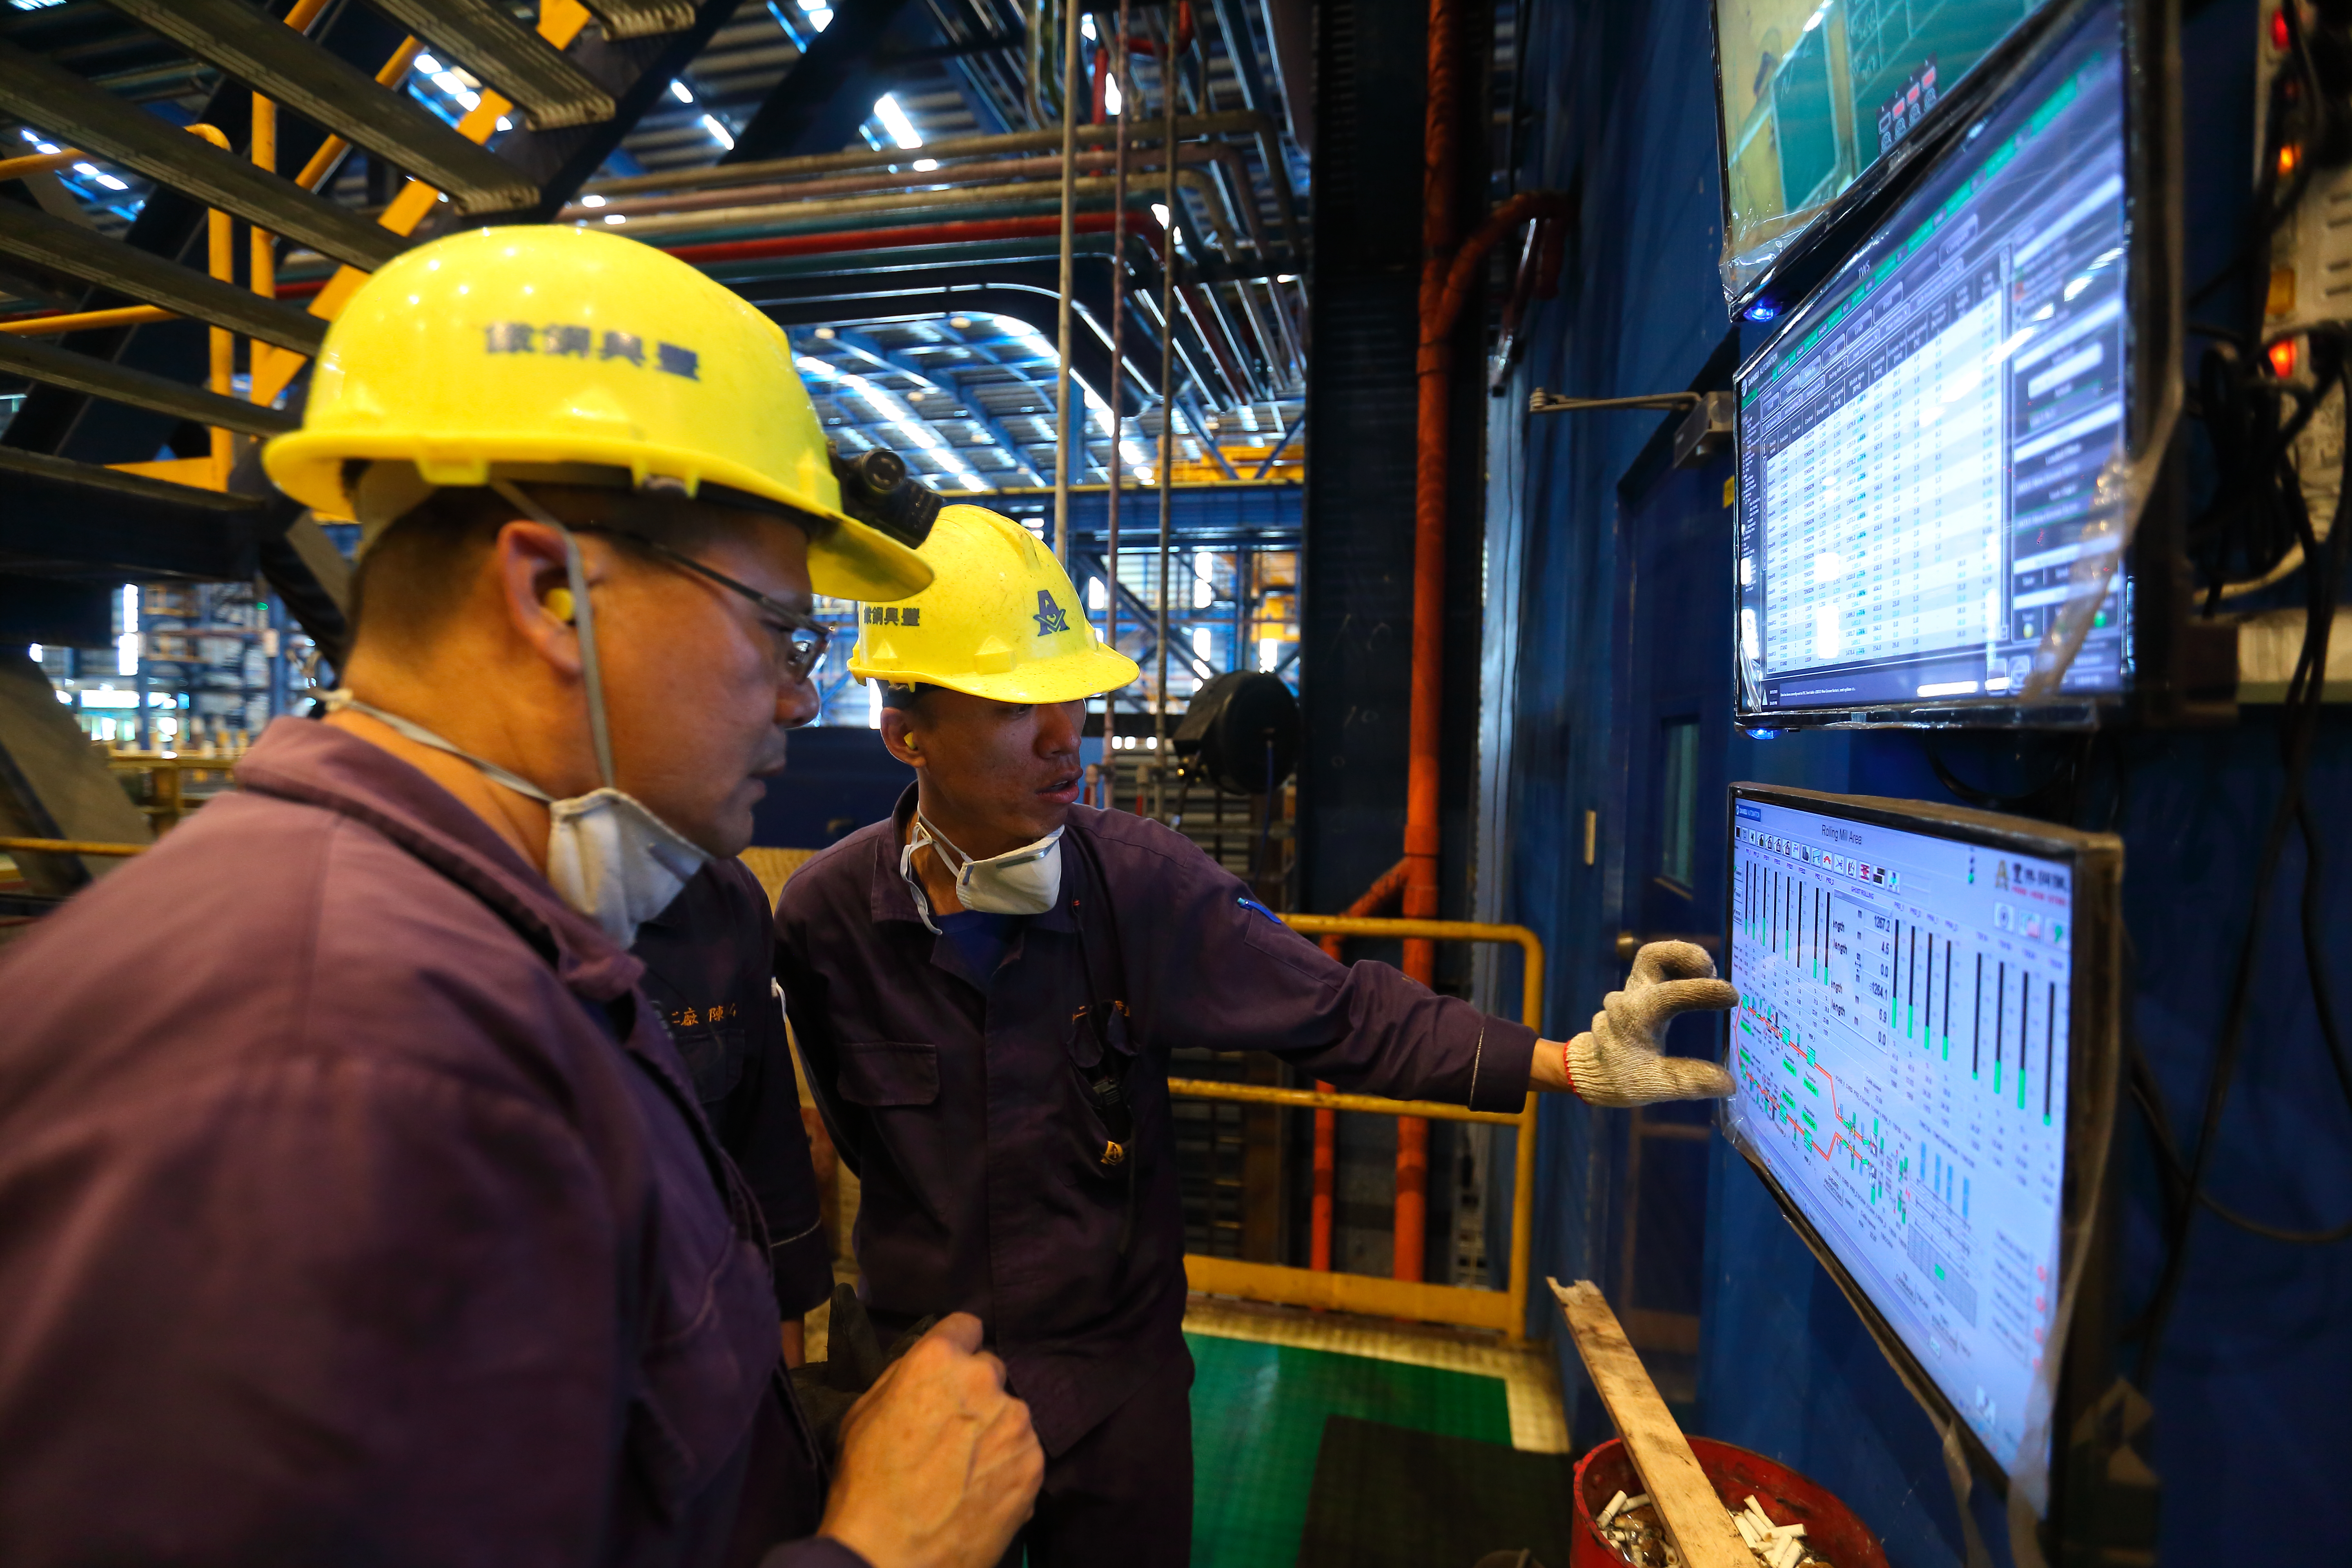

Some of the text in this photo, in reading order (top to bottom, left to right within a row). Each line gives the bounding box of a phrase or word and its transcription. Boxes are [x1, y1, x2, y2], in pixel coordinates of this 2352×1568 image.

[1858, 262, 1869, 280] TWS
[1855, 323, 1863, 336] Grab
[1760, 352, 1777, 375] AUTOMATION
[1816, 403, 1829, 417] Elongation
[1780, 433, 1788, 443] Function
[1822, 824, 1862, 844] Rolling Mill Area
[1881, 941, 1889, 955] 4.5
[1833, 939, 1847, 955] length
[1880, 964, 1889, 977] 0.0
[1831, 999, 1845, 1017] length
[1879, 1009, 1887, 1023] 6.9
[1803, 1113, 1815, 1129] PRESSURE
[1824, 1178, 1842, 1203] PROTECTIONS
[1828, 1175, 1839, 1190] SHEARS
